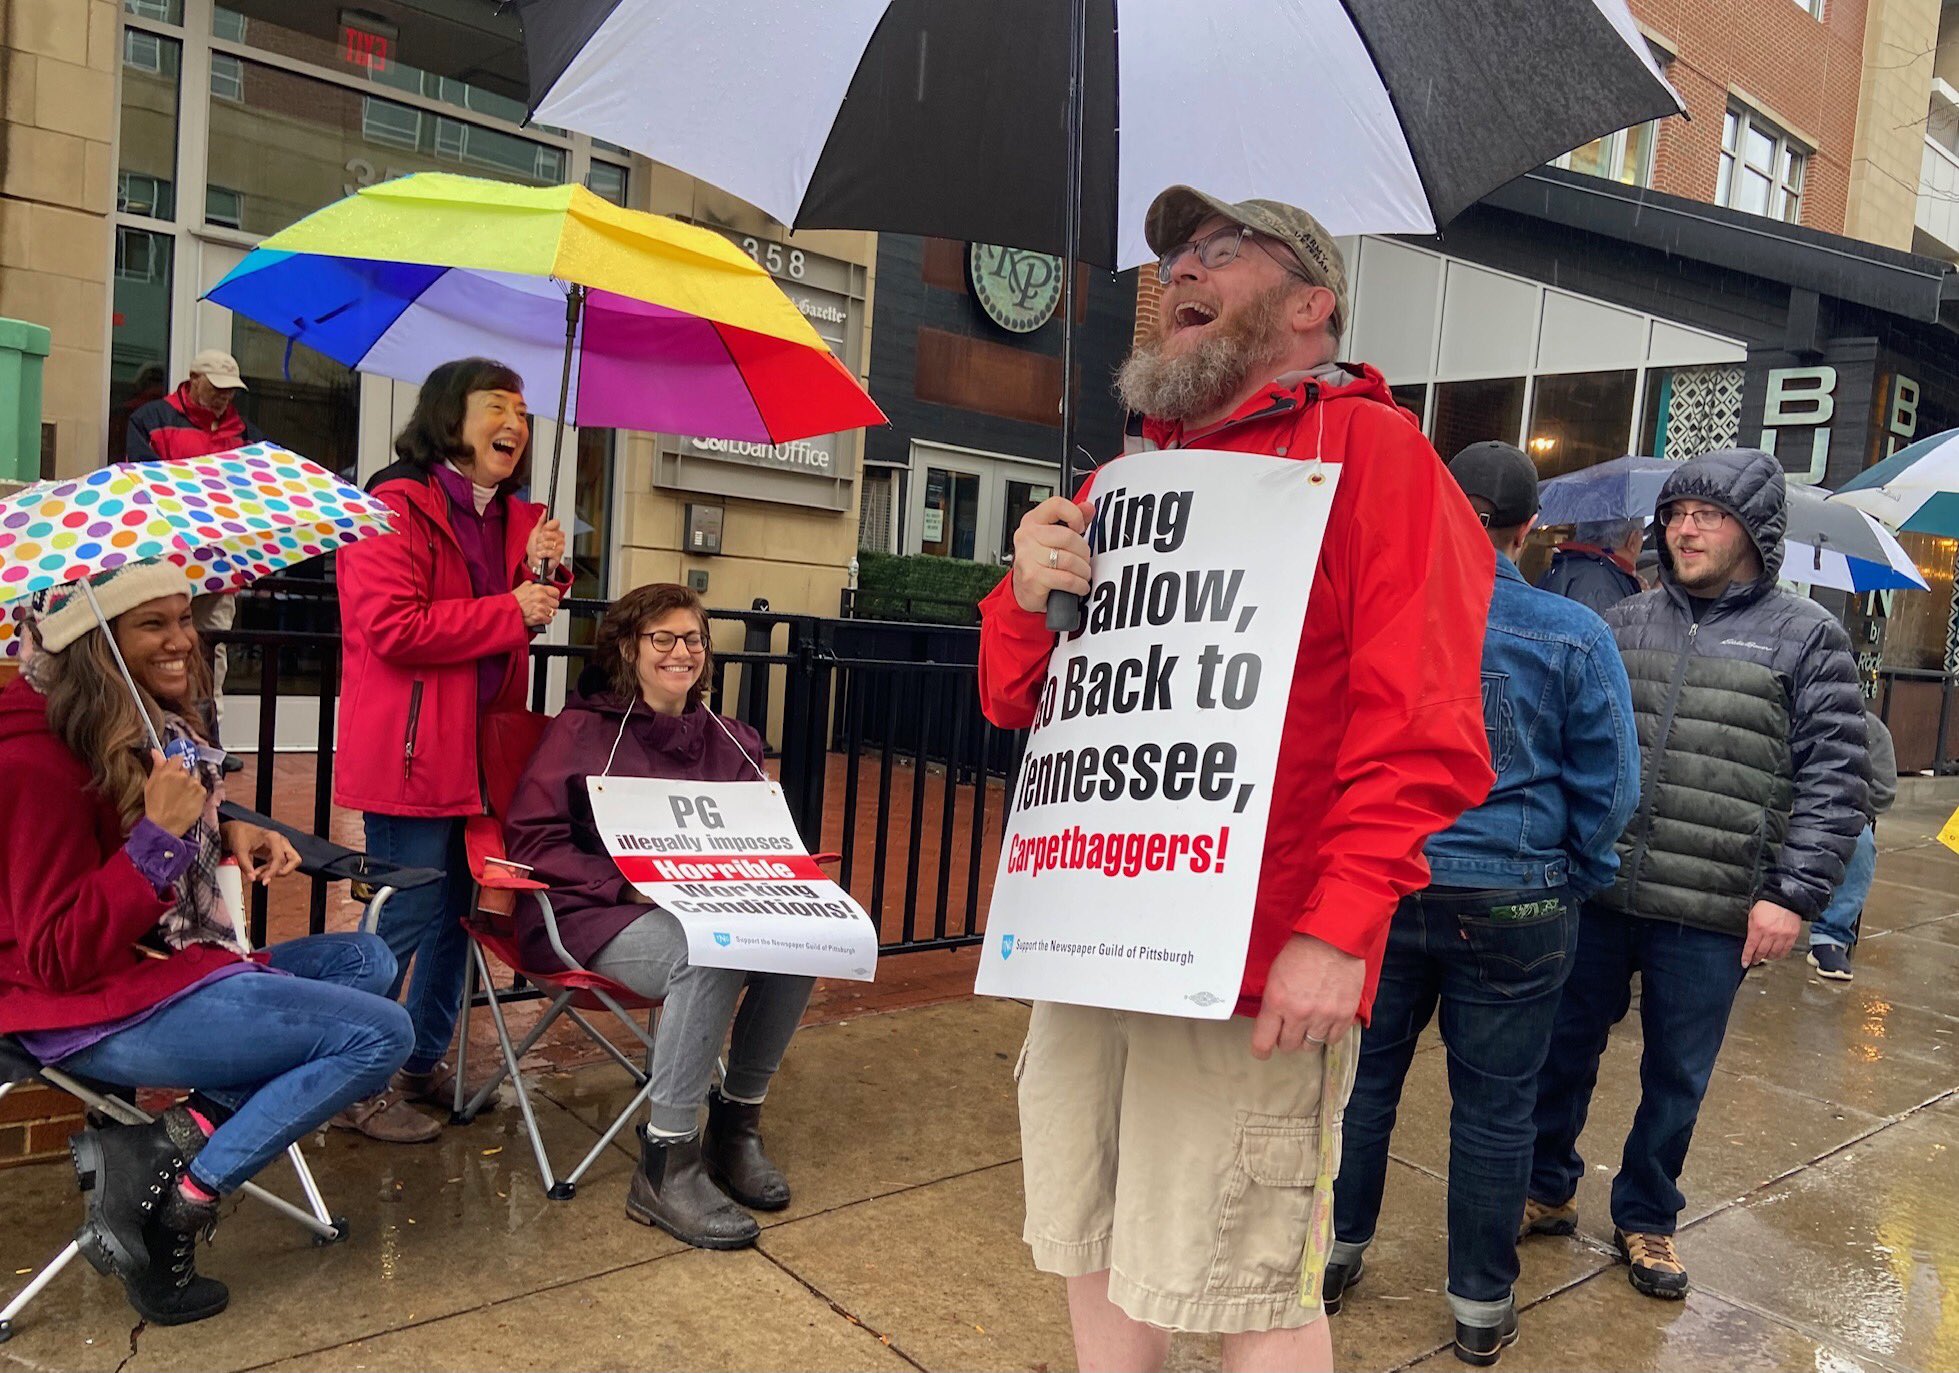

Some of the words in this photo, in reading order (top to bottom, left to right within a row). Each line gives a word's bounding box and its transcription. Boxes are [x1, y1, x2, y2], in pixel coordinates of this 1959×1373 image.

[743, 237, 805, 279] 358
[1294, 231, 1329, 273] VETERAN
[1303, 234, 1328, 260] ARMY
[775, 441, 830, 467] Office
[1088, 487, 1195, 558] King
[1060, 644, 1180, 721] Back
[1196, 645, 1262, 710] to
[1016, 742, 1256, 814] Tennessee,
[667, 794, 726, 830] PG
[615, 834, 702, 853] illegally
[706, 834, 794, 853] imposes
[1007, 825, 1231, 878] Carpetbaggers!
[653, 858, 797, 880] Horrible
[674, 882, 820, 899] Working
[671, 899, 860, 920] Conditions!
[736, 936, 760, 945] Support
[761, 937, 771, 946] the
[772, 939, 804, 949] Newspaper
[806, 942, 821, 951] Guild
[828, 944, 856, 955] Pittsburgh
[1016, 939, 1037, 953] Support
[1038, 939, 1049, 952] the
[1050, 940, 1096, 957] Newspaper
[1099, 942, 1124, 958] Guild
[1126, 945, 1137, 959] of
[1139, 946, 1195, 967] Pittsburgh
